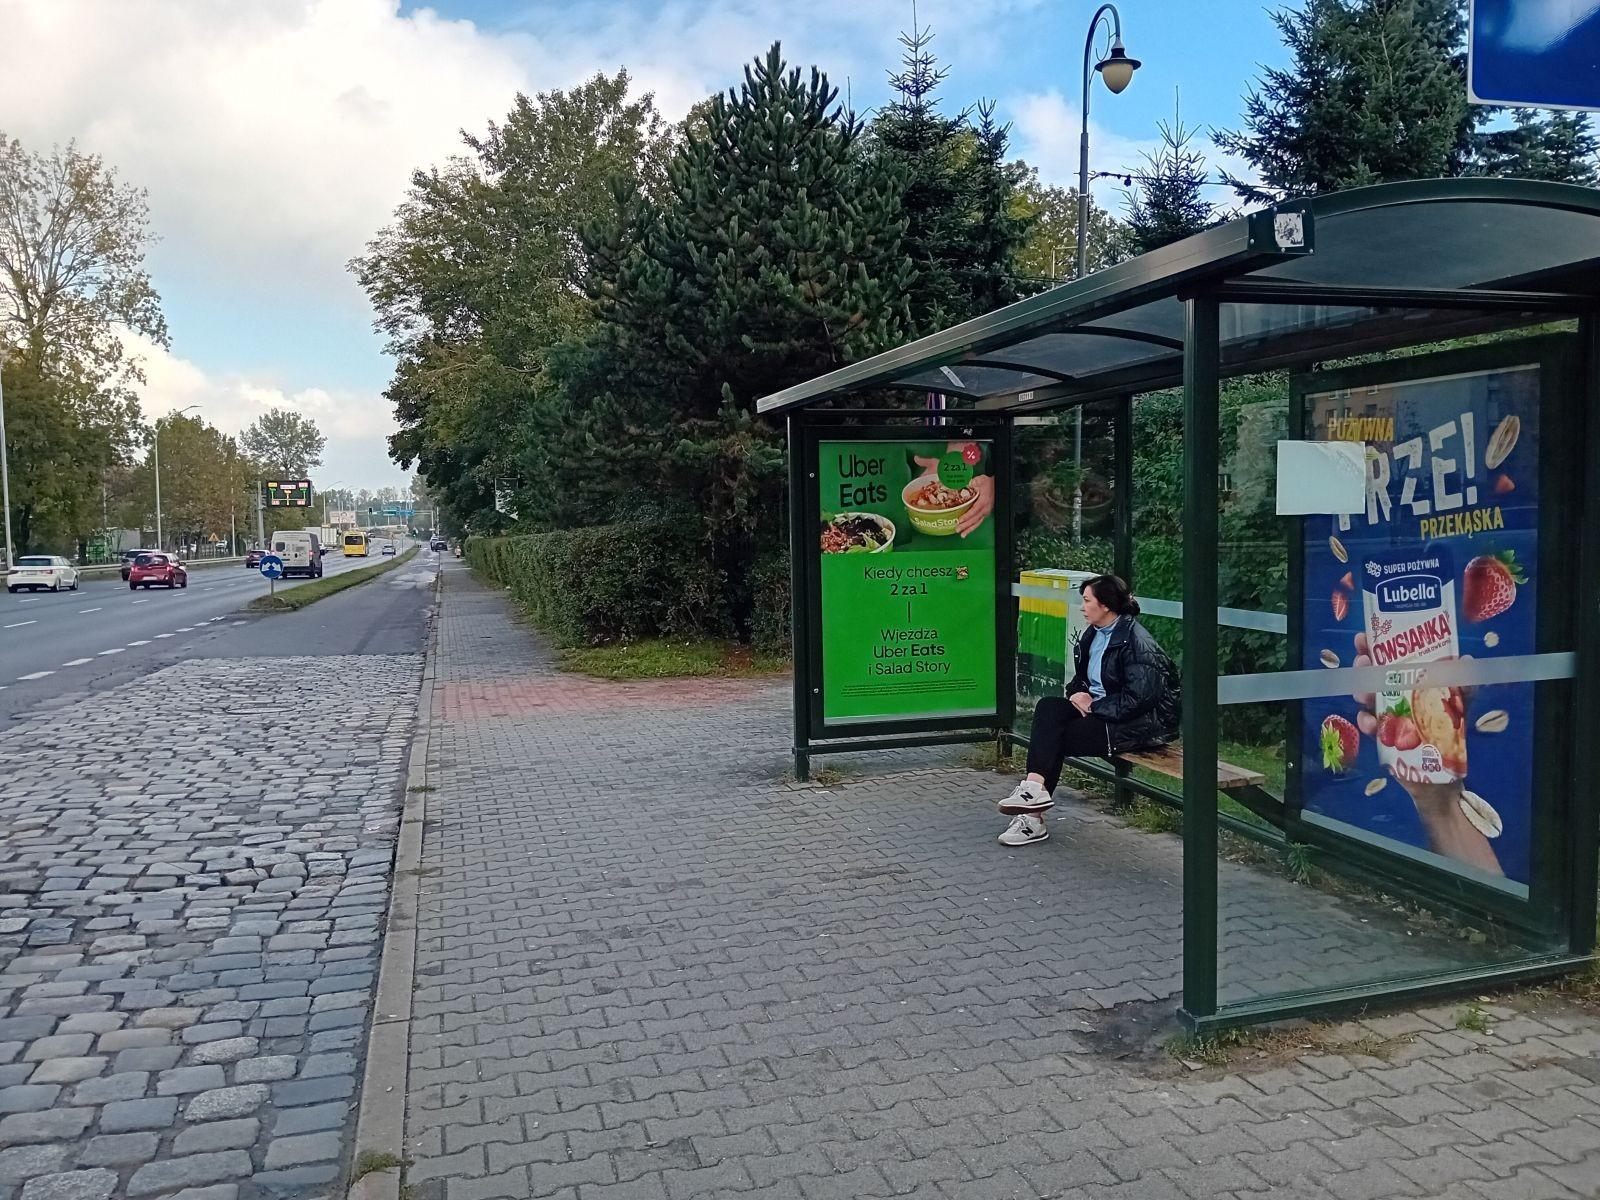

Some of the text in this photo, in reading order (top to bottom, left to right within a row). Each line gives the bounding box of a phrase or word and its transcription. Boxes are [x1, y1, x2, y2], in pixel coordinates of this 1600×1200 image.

[1327, 415, 1394, 441] POŻYWNA
[838, 454, 885, 478] Uber
[943, 462, 968, 472] 2 za 1
[839, 481, 888, 508] Eats
[1420, 506, 1504, 541] PRZEKĄSKA
[864, 565, 953, 581] Kiedy chcesz
[1383, 558, 1440, 575] SUPER POŻYWNA
[890, 583, 928, 596] 2 za 1
[1383, 583, 1436, 603] Lubella
[880, 627, 938, 644] Wjeżdża
[1372, 612, 1452, 666] OWSIANKA
[873, 643, 945, 659] Uber Eats
[875, 661, 912, 675] Salad
[915, 660, 951, 674] Story
